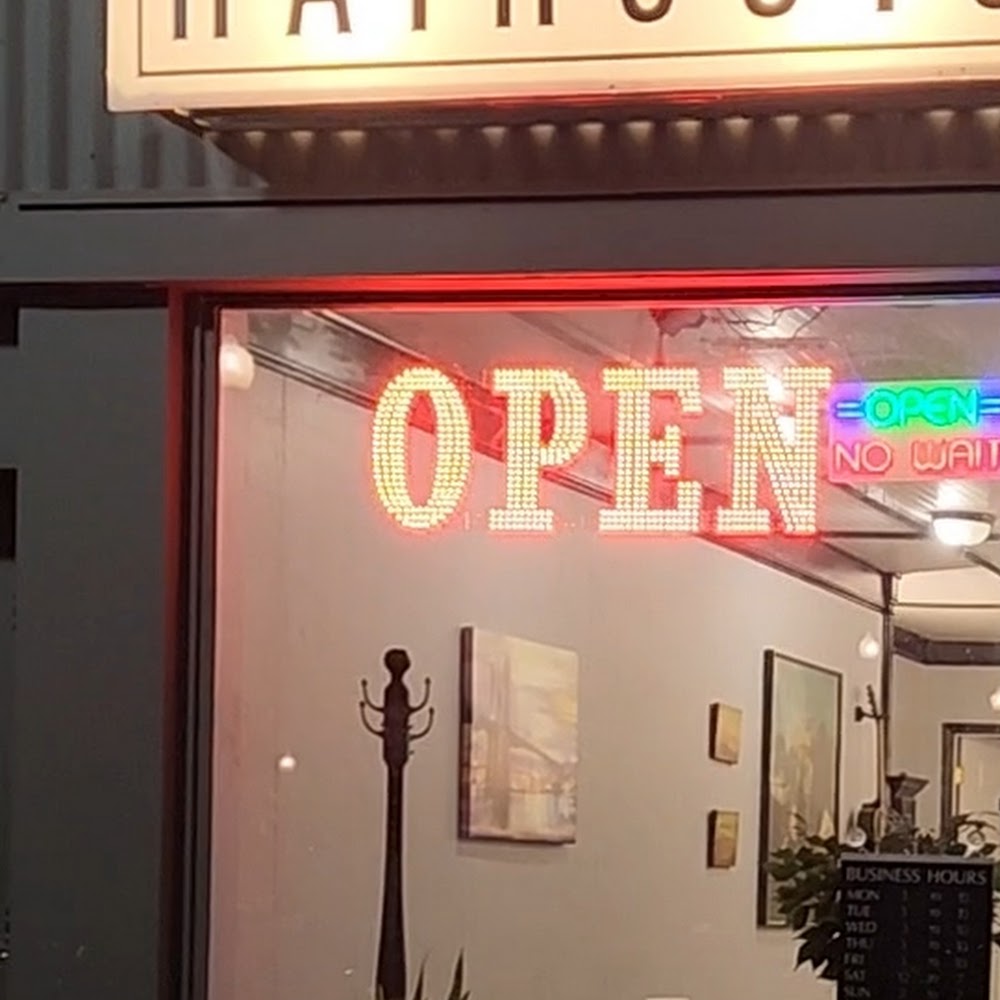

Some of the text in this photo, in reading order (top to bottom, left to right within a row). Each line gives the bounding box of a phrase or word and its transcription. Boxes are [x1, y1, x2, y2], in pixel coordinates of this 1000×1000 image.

[865, 388, 979, 427] OPEN
[370, 366, 832, 534] OPEN
[834, 441, 893, 473] NO
[845, 866, 988, 886] BUSINESS HOURS
[846, 904, 871, 918] TUE
